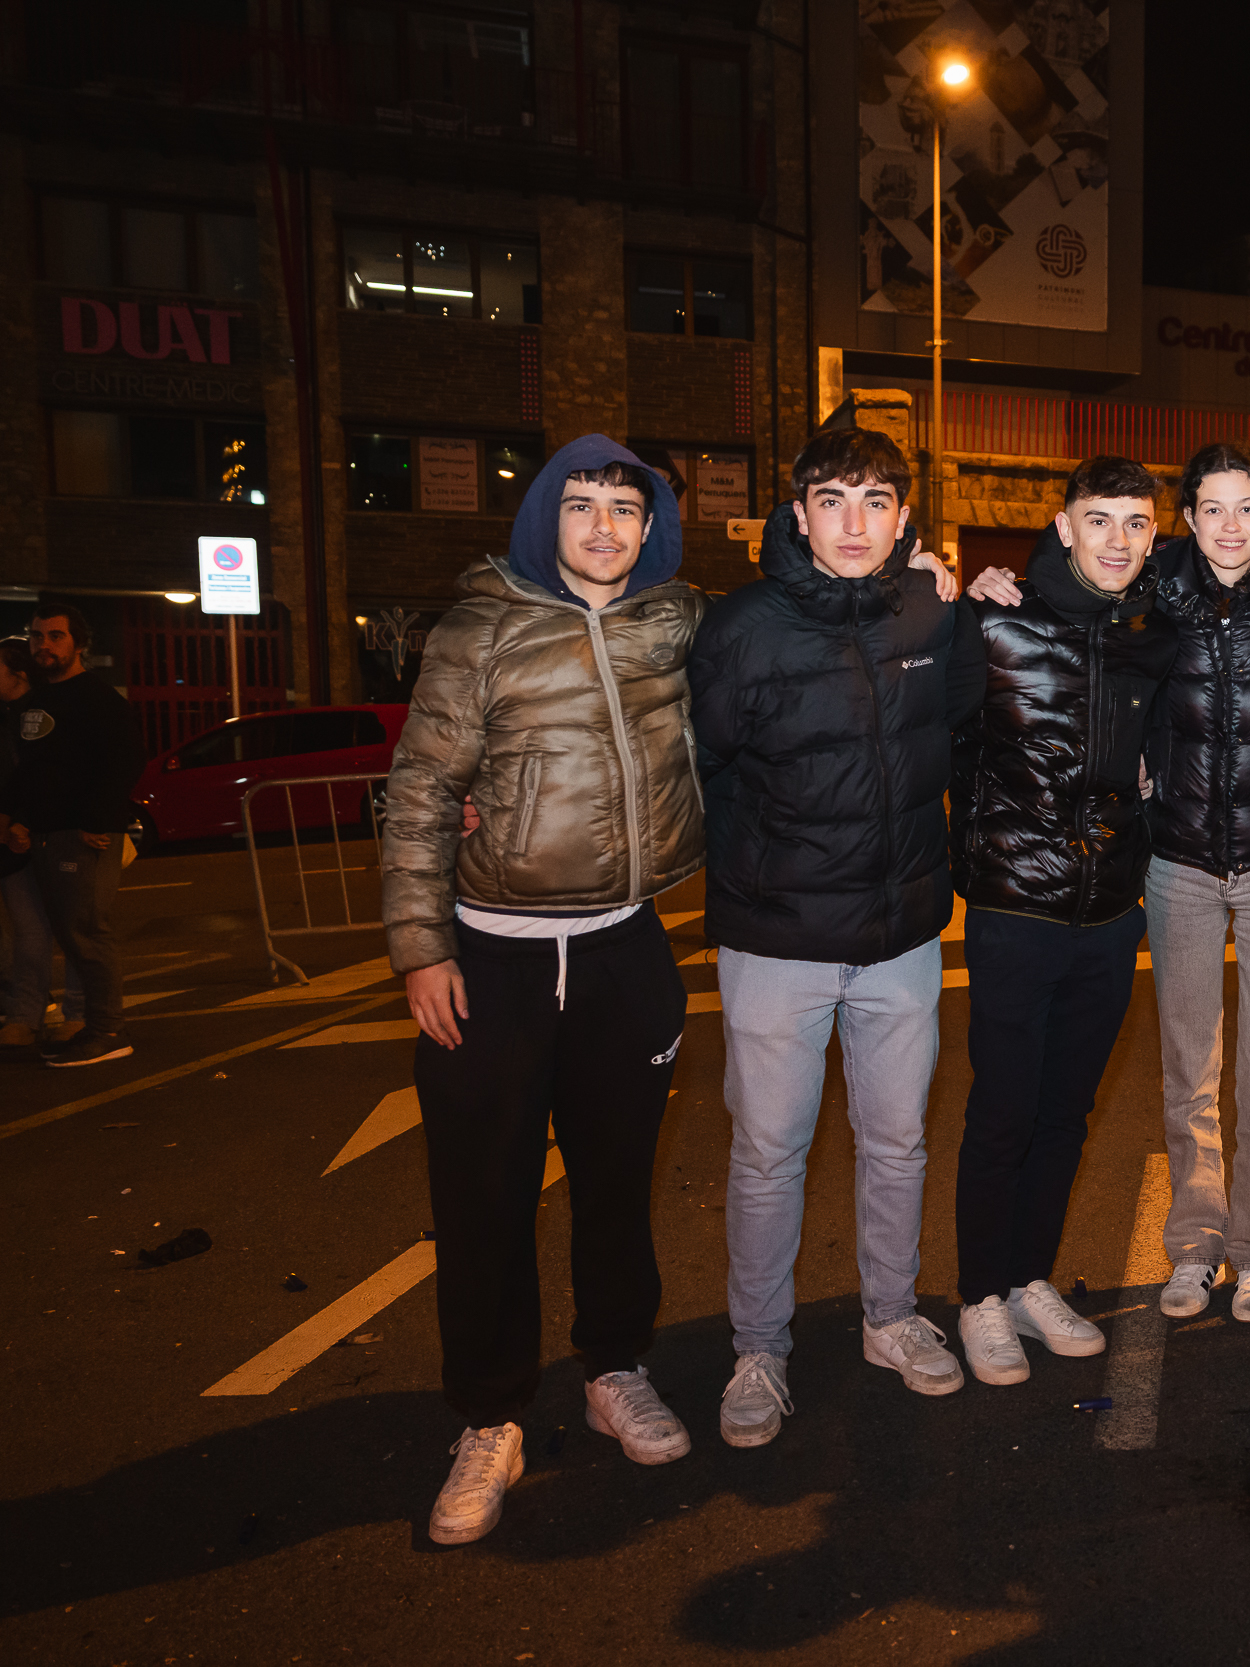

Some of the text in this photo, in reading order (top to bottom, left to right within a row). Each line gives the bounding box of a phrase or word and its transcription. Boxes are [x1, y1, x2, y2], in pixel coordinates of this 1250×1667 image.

[52, 370, 157, 398] CENTRE
[711, 477, 735, 486] M&M
[908, 656, 934, 668] Columbia
